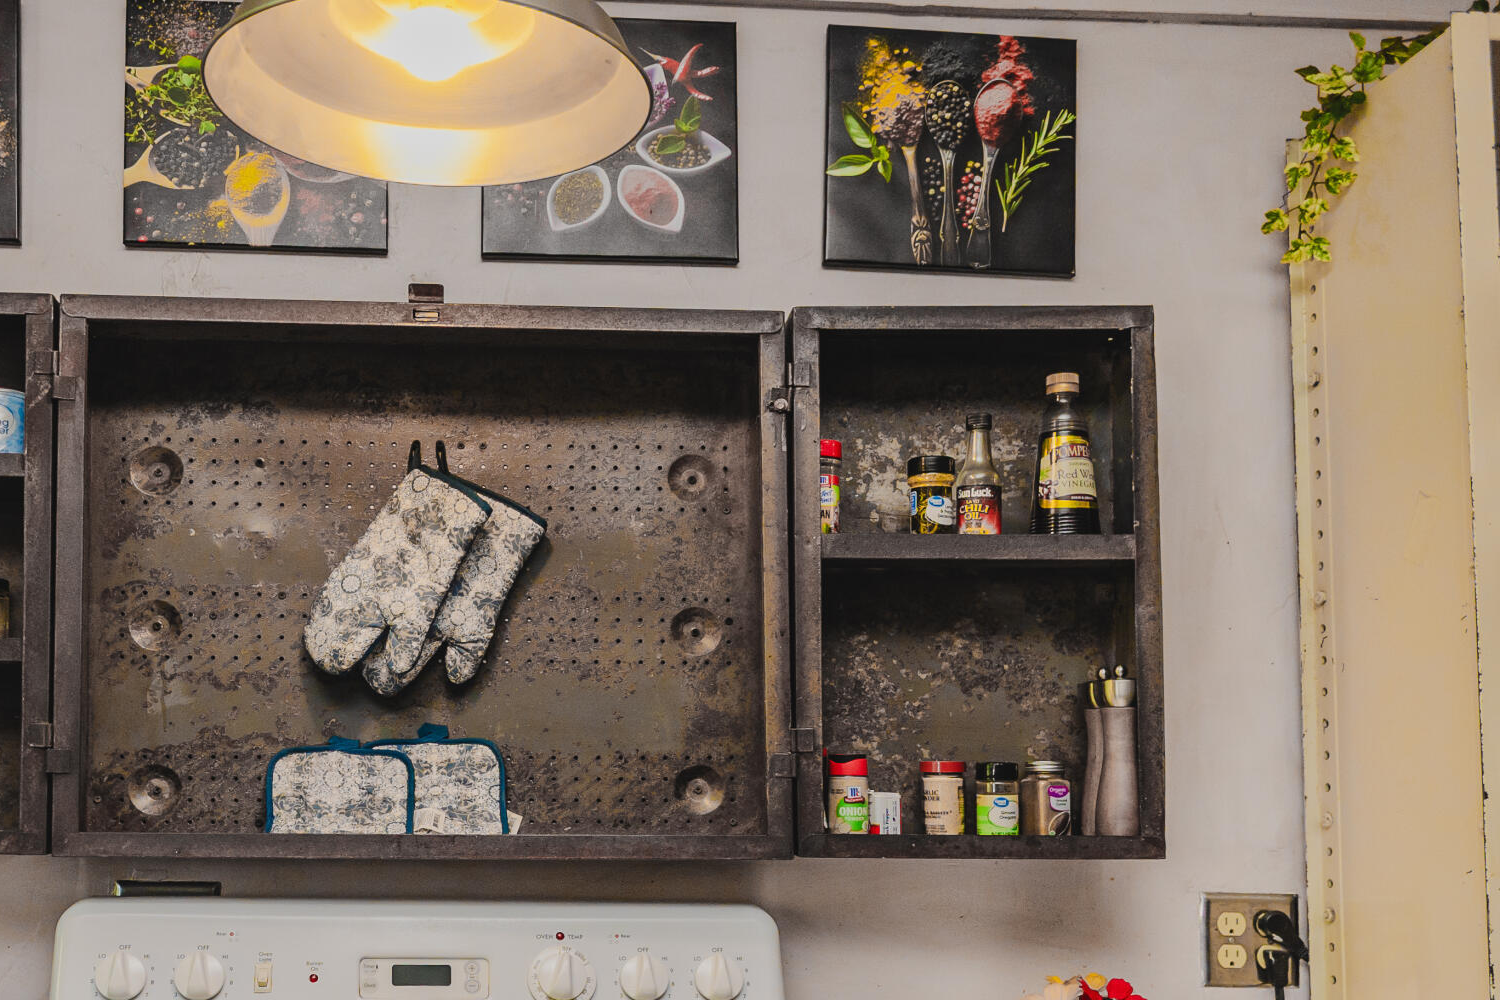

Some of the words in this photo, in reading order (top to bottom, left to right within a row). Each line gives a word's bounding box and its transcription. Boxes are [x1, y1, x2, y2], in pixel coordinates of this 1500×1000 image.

[1057, 468, 1078, 479] Red
[958, 489, 971, 498] Sun
[960, 503, 990, 514] CHILI
[964, 512, 981, 520] OIL
[839, 806, 868, 817] ONION
